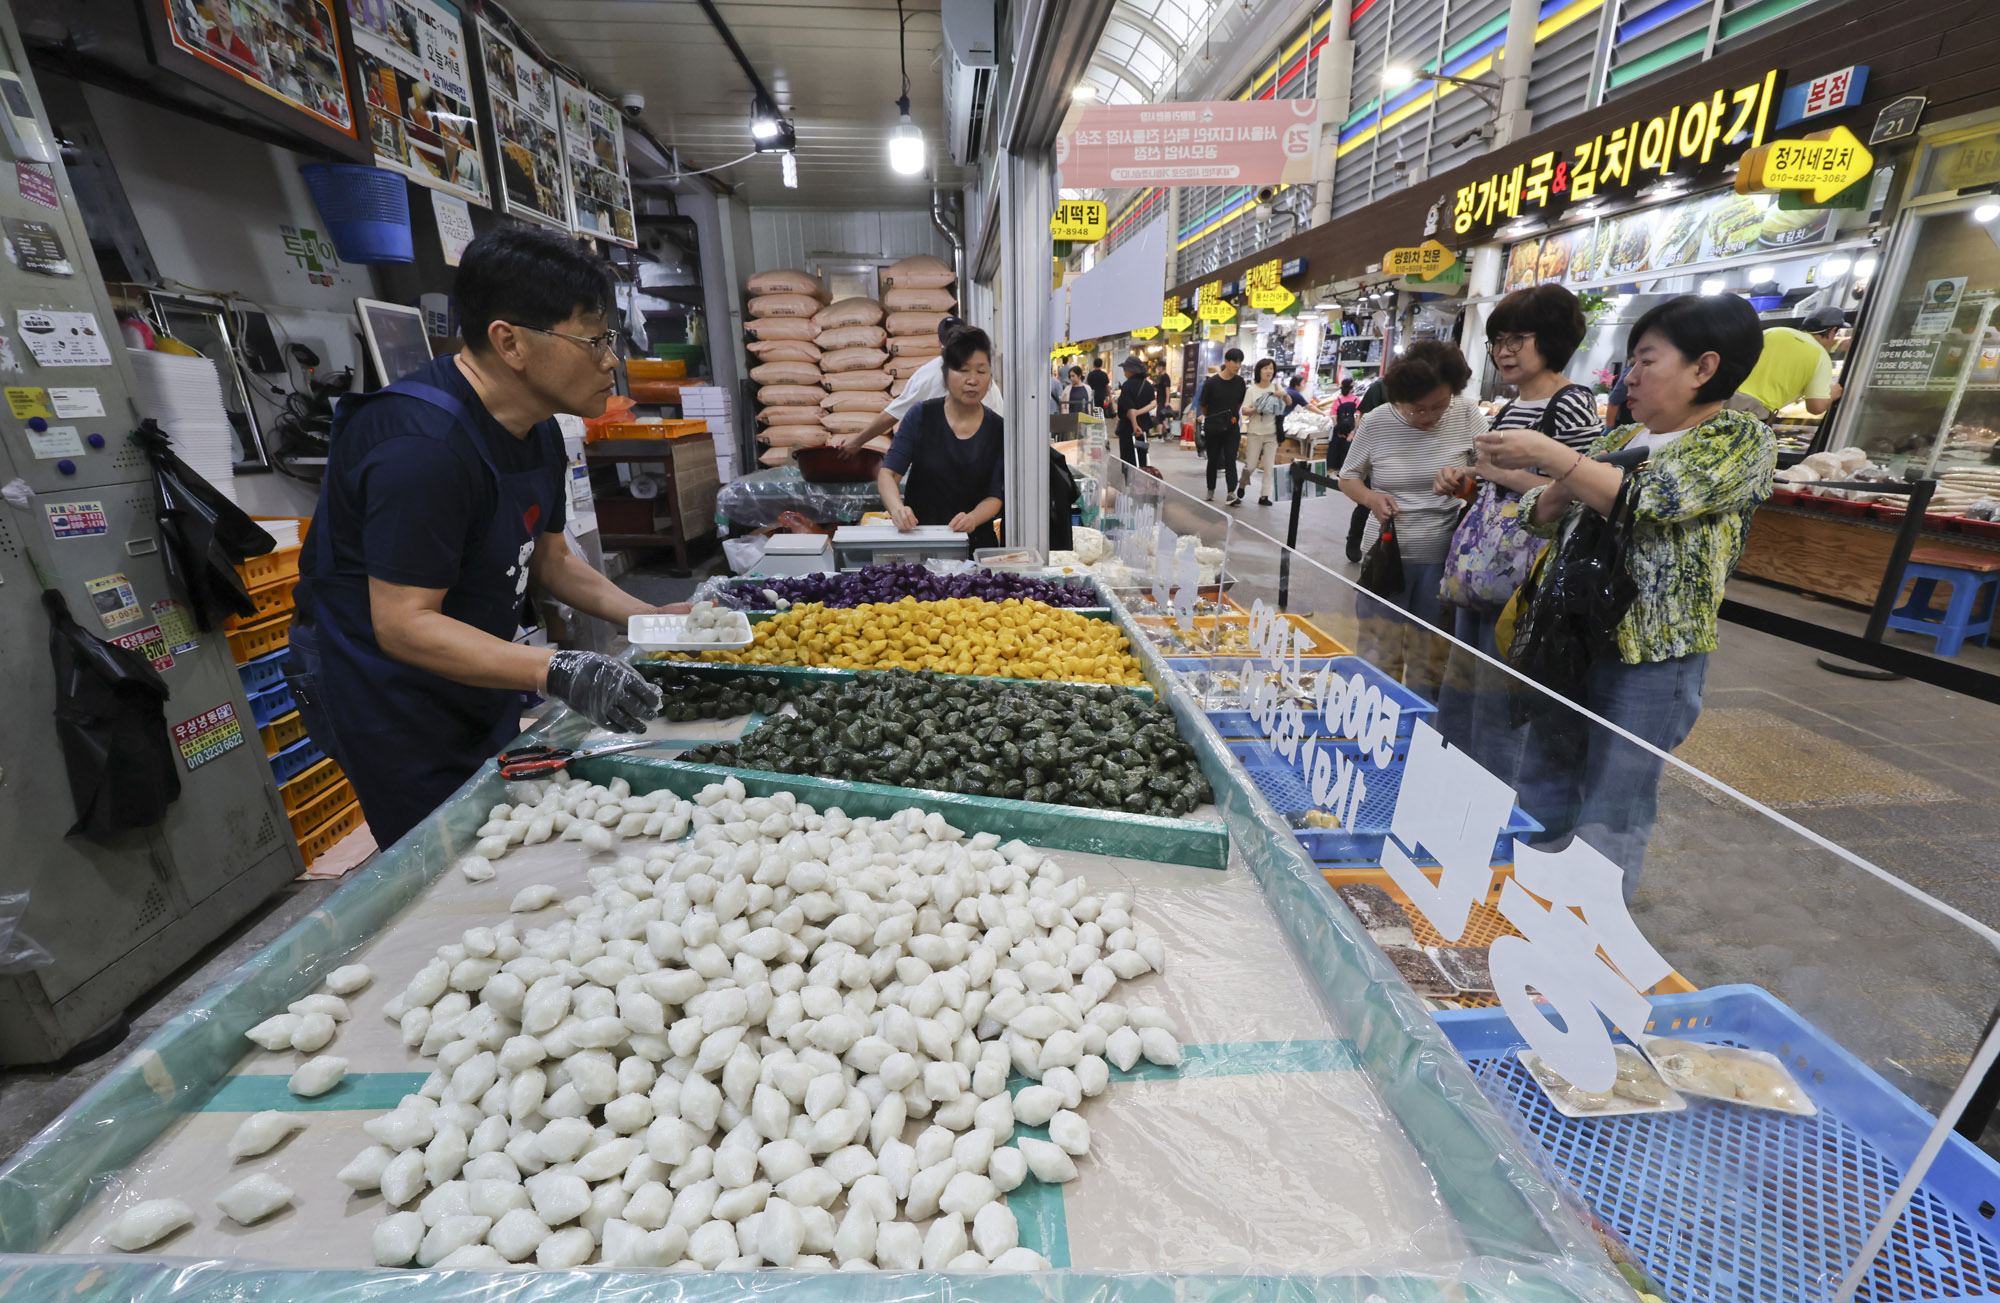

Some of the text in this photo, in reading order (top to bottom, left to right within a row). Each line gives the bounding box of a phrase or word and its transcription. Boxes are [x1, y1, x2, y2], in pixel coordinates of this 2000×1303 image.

[1807, 71, 1849, 113] 본점
[1883, 118, 1904, 136] 21
[1776, 147, 1854, 170] 정가네김치
[1770, 173, 1847, 183] 010-4922-3062
[1394, 249, 1440, 264] 쌍화차 전문
[1256, 292, 1289, 302] 동산건어물
[1879, 351, 1901, 359] OPEN
[176, 710, 218, 738] 우성냉동
